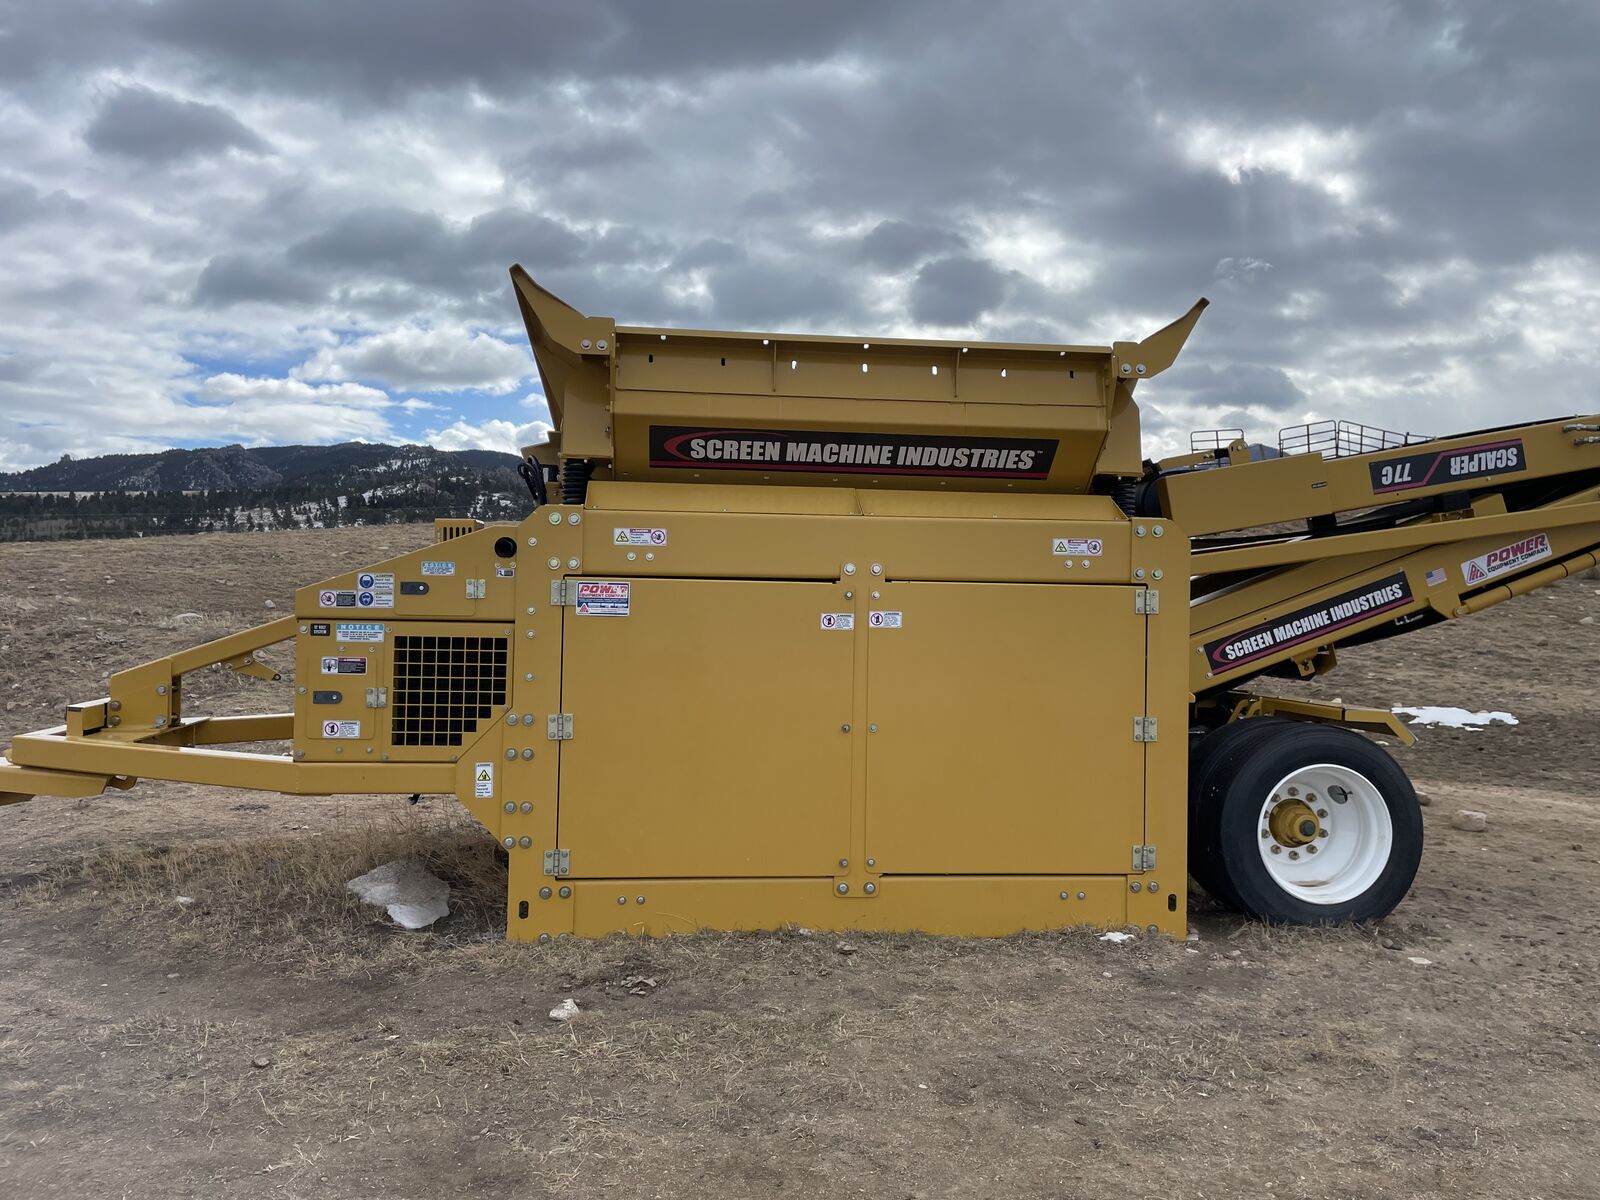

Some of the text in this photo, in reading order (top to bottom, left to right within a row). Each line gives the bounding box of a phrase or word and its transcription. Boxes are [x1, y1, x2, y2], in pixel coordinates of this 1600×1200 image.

[690, 438, 1035, 470] SCREEN MACHINE INDUSTRIES
[1381, 447, 1518, 485] SCALPER 77C
[1486, 534, 1546, 567] POWER
[1487, 556, 1520, 573] EQUIPMENT
[1520, 545, 1549, 561] COMPANY
[1225, 630, 1274, 660] SCREEN
[1272, 609, 1331, 643] MACHINE
[1329, 583, 1403, 622] INDUSTRIES
